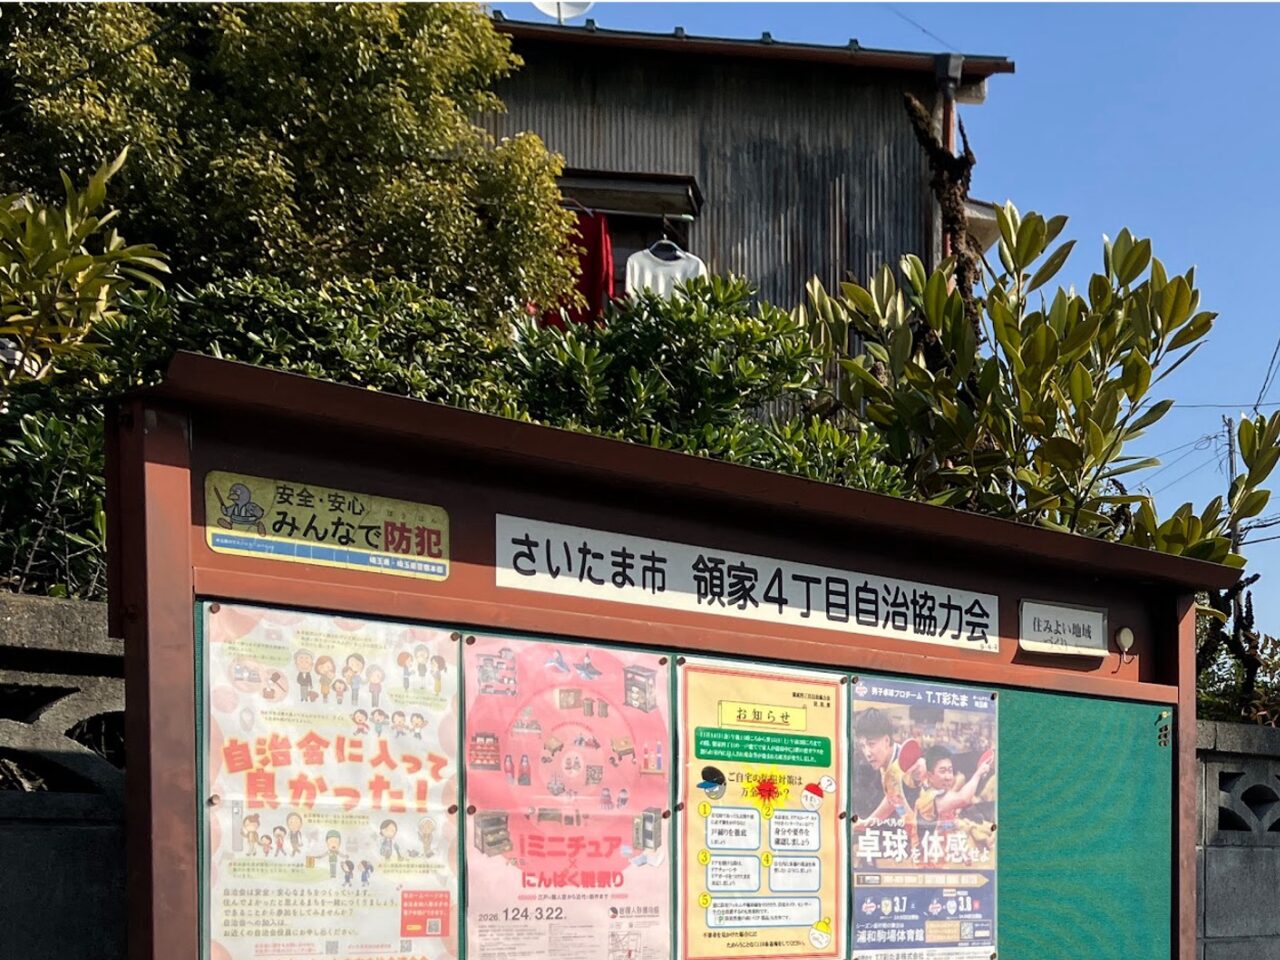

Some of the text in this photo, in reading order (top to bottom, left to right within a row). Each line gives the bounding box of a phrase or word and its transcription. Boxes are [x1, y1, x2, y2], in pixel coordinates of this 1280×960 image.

[275, 484, 365, 516] 安全・安心
[272, 511, 442, 559] みんなで防犯
[511, 533, 990, 643] さいたま市 領家4丁目自治協力会
[1033, 617, 1092, 639] 住みよい地域
[736, 707, 791, 724] お知らせ
[222, 731, 449, 783] 自治会に入って
[856, 828, 991, 863] 卓球を体感せよ
